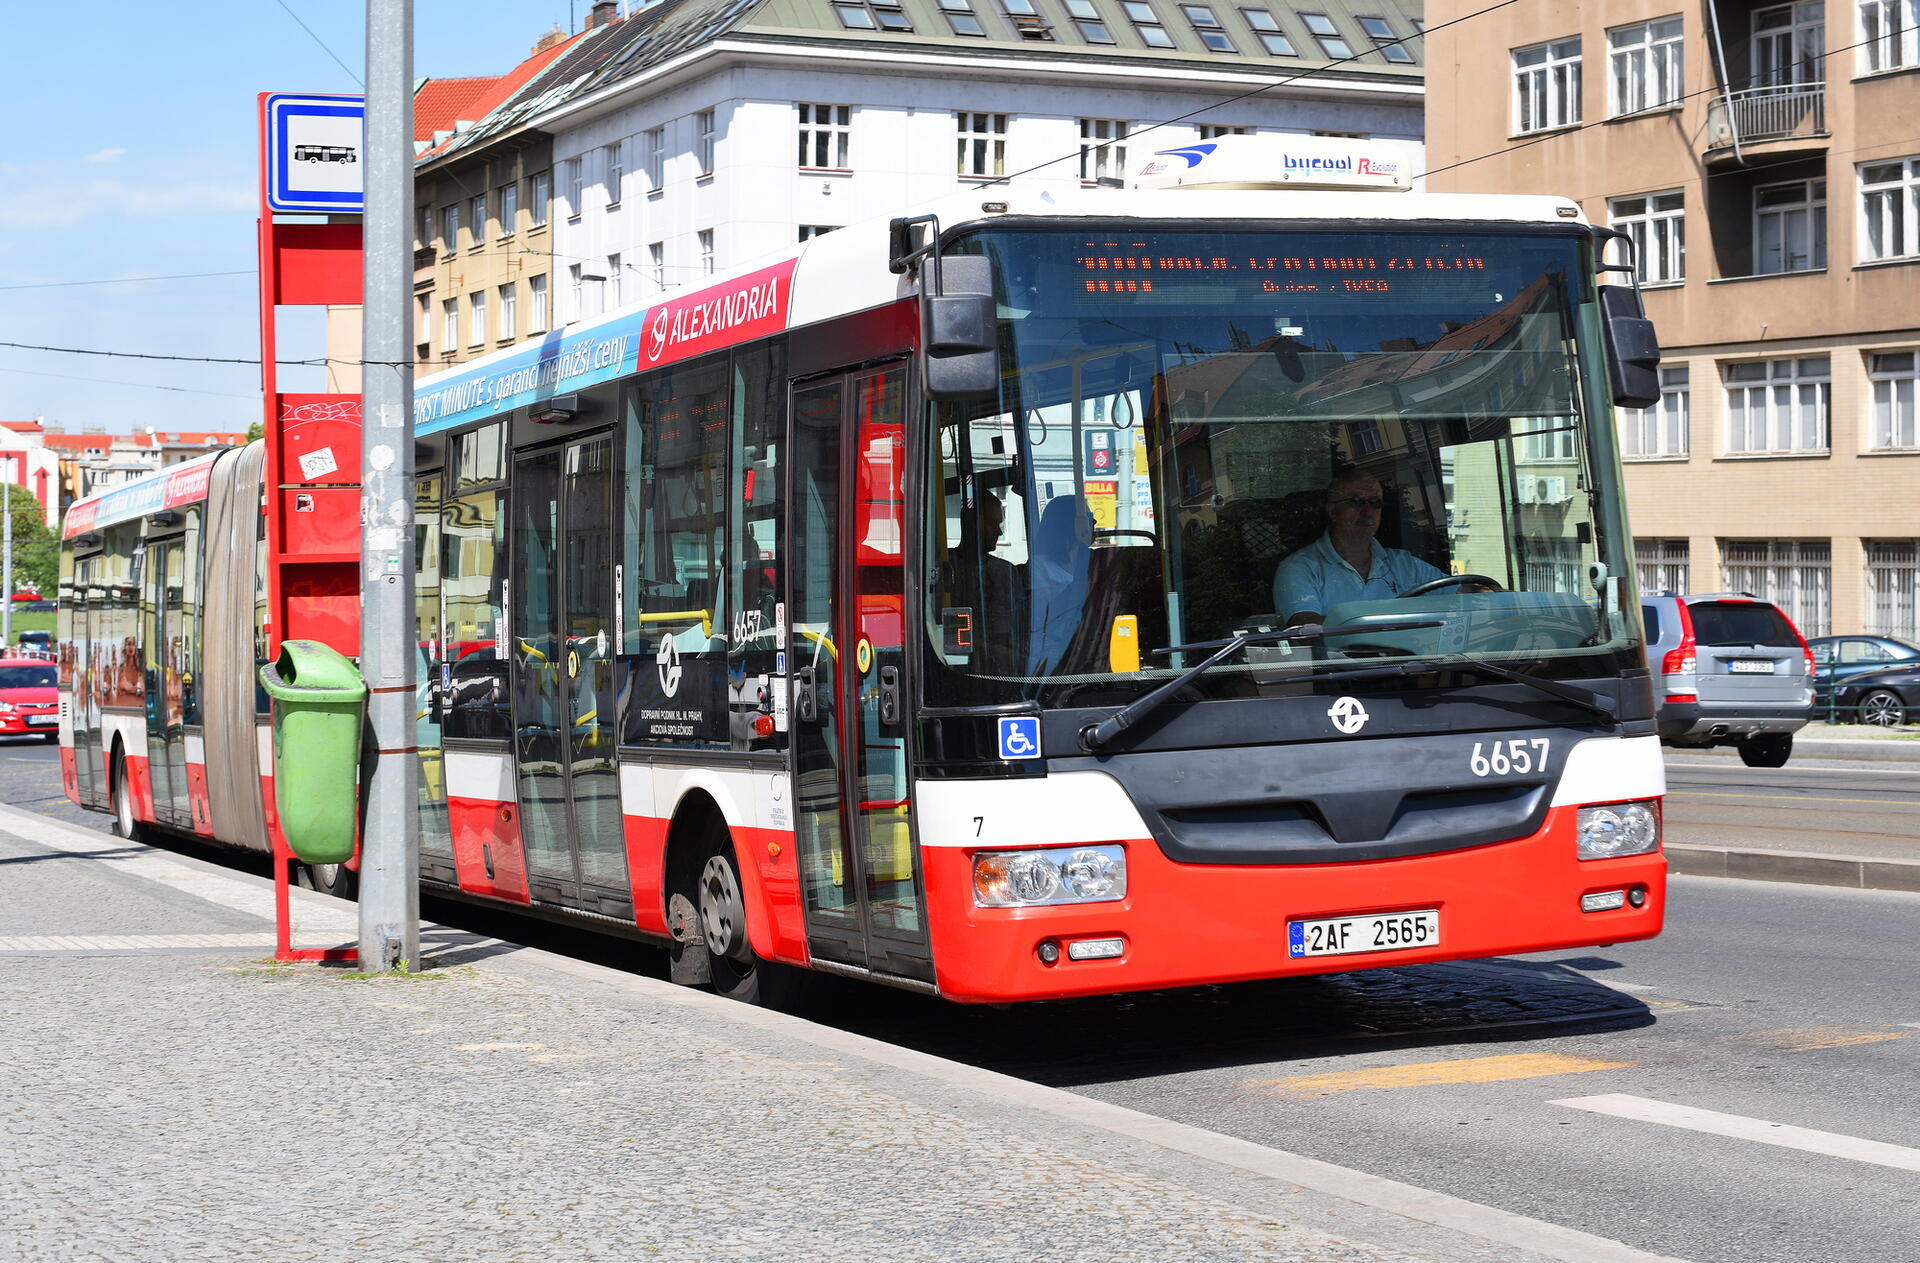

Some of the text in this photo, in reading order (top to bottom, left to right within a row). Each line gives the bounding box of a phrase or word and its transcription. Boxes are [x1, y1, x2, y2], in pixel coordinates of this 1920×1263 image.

[669, 277, 777, 346] ALEXANDRIA
[440, 376, 487, 417] MINUTE
[486, 380, 494, 404] s
[594, 336, 628, 374] ceny
[733, 609, 761, 643] 6657
[957, 613, 971, 646] 2
[1470, 737, 1550, 777] 6657
[973, 816, 984, 838] 7
[1292, 916, 1428, 953] CZ 2AF 2565
